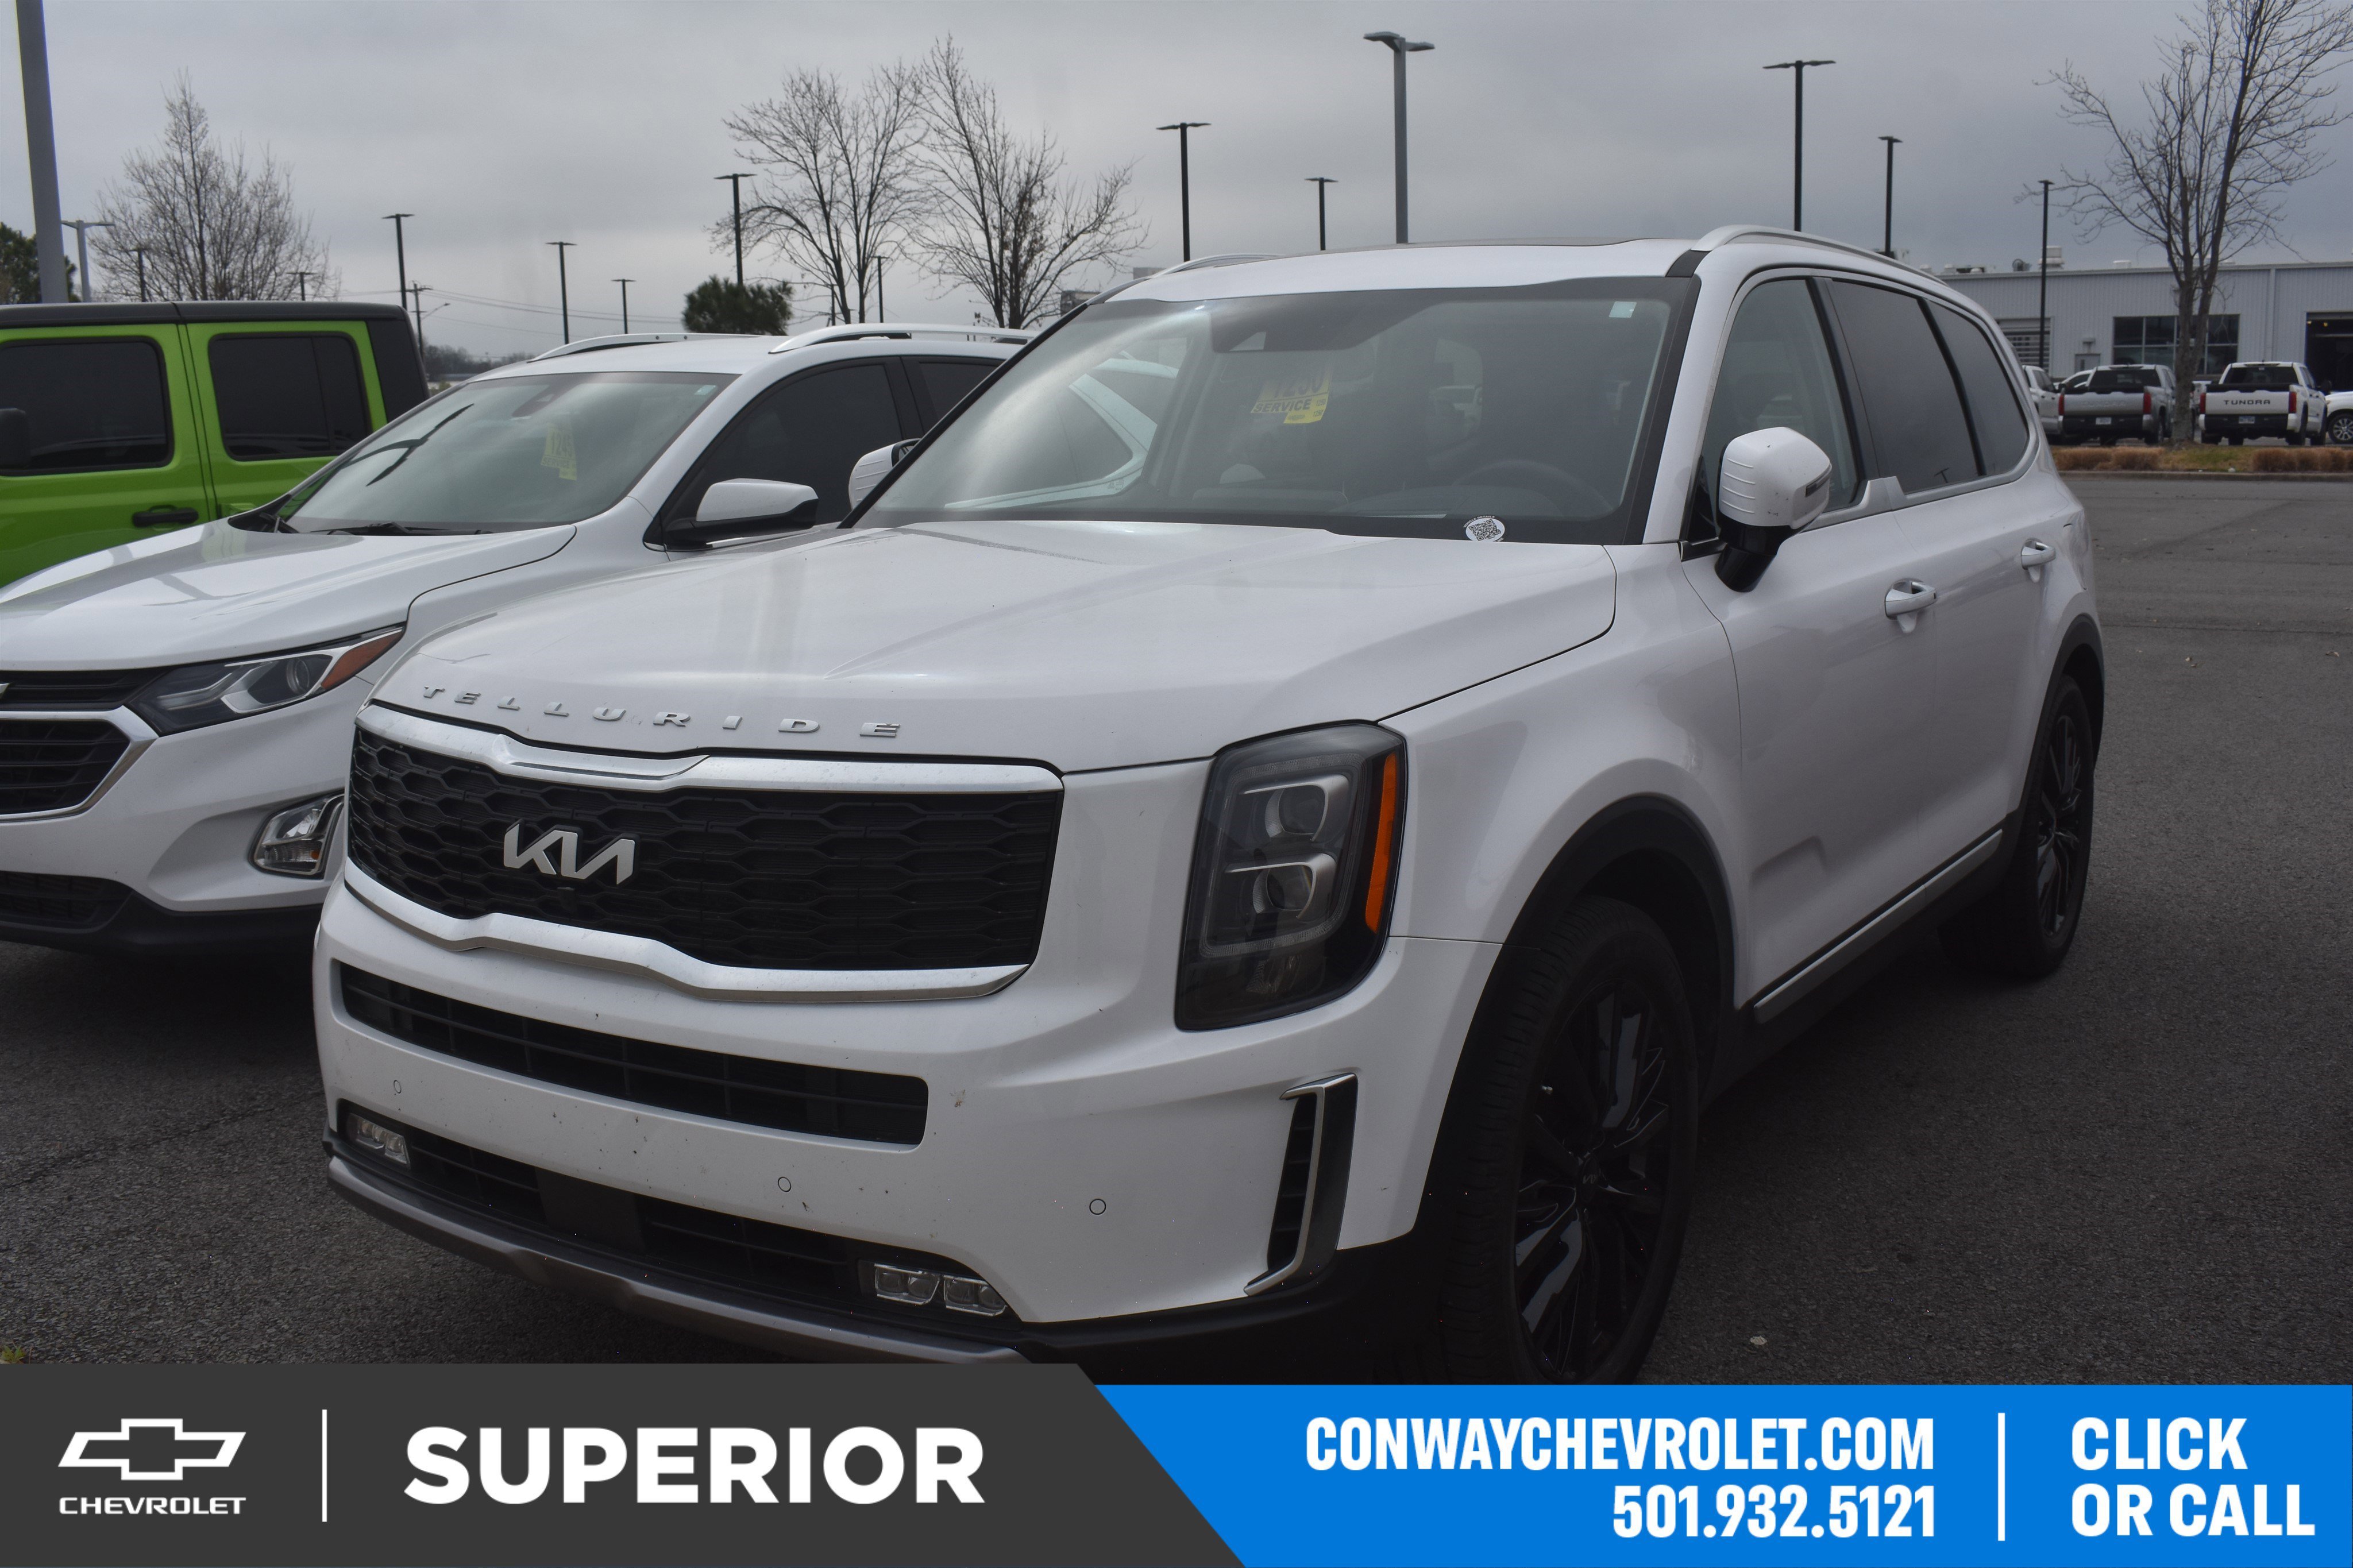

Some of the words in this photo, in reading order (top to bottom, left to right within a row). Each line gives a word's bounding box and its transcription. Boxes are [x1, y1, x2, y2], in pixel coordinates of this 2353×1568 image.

[1253, 399, 1312, 412] SERVICE
[423, 686, 900, 737] TELLURIDE
[503, 823, 635, 885] KIA
